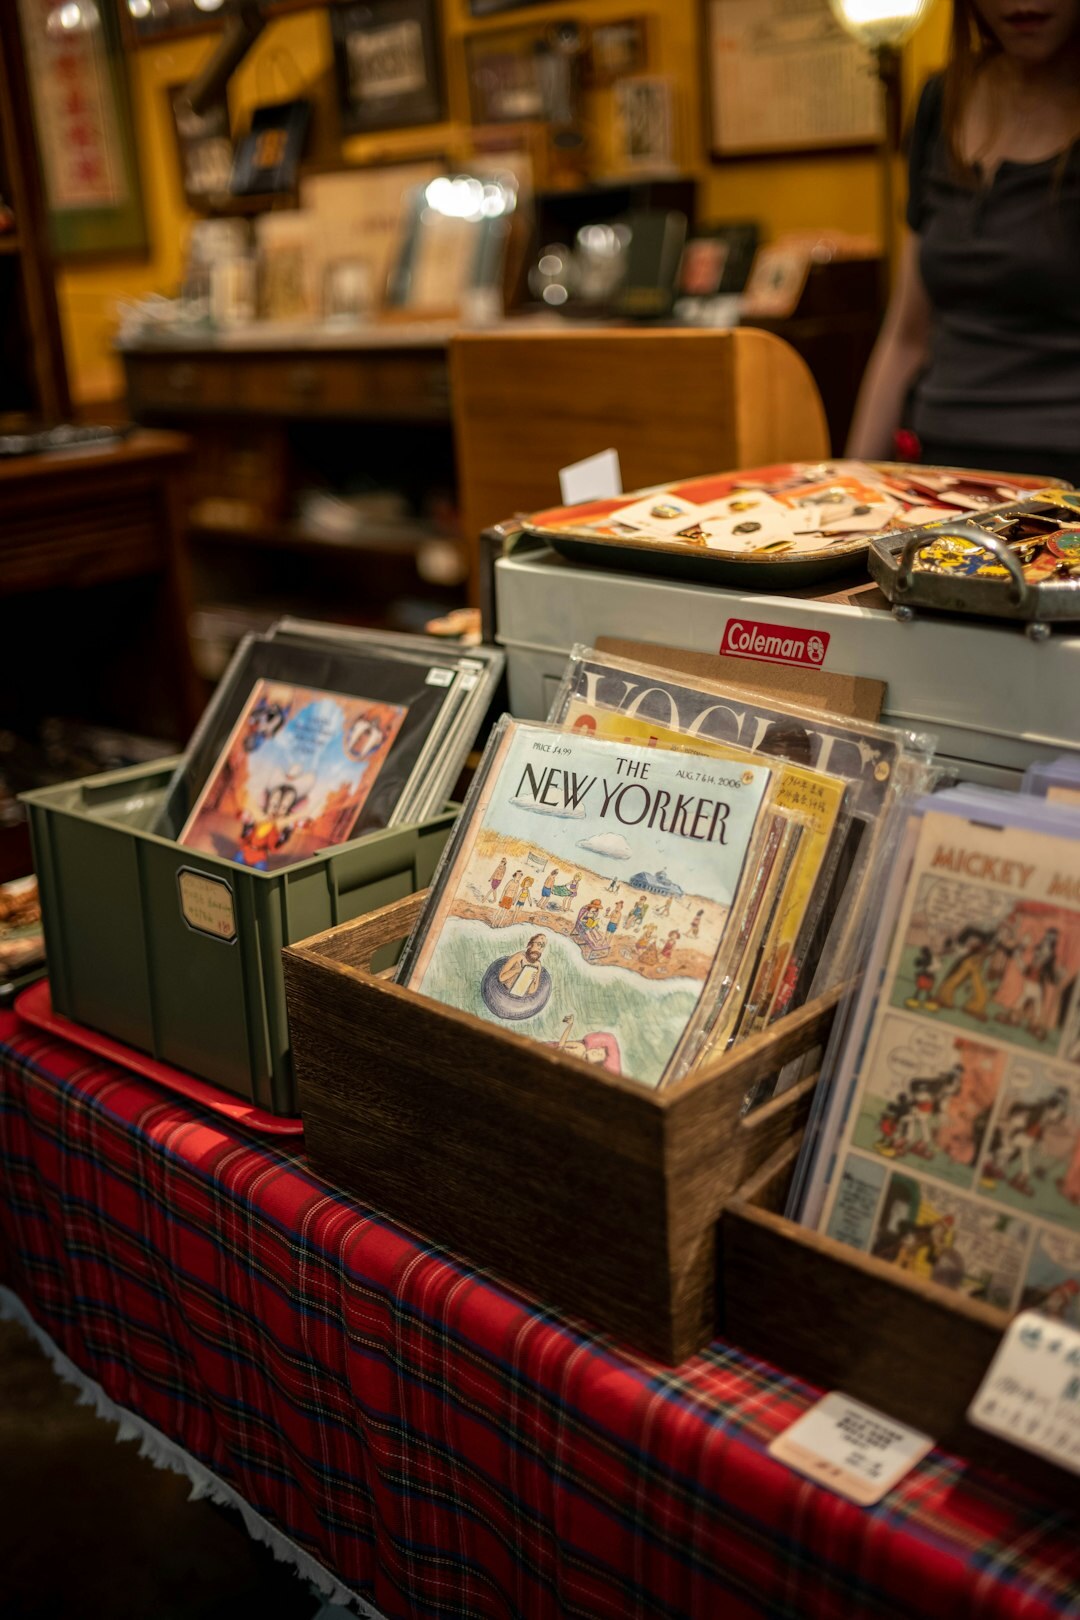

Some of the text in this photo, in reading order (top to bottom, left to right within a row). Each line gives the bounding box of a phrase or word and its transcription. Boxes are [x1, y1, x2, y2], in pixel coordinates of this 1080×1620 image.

[727, 622, 805, 659] Coleman
[532, 742, 572, 756] PRICE $4.99
[616, 757, 651, 780] THE
[717, 777, 741, 789] 2006
[515, 763, 598, 810] NEW
[600, 778, 731, 845] YORKER
[930, 844, 1036, 889] MICKEY
